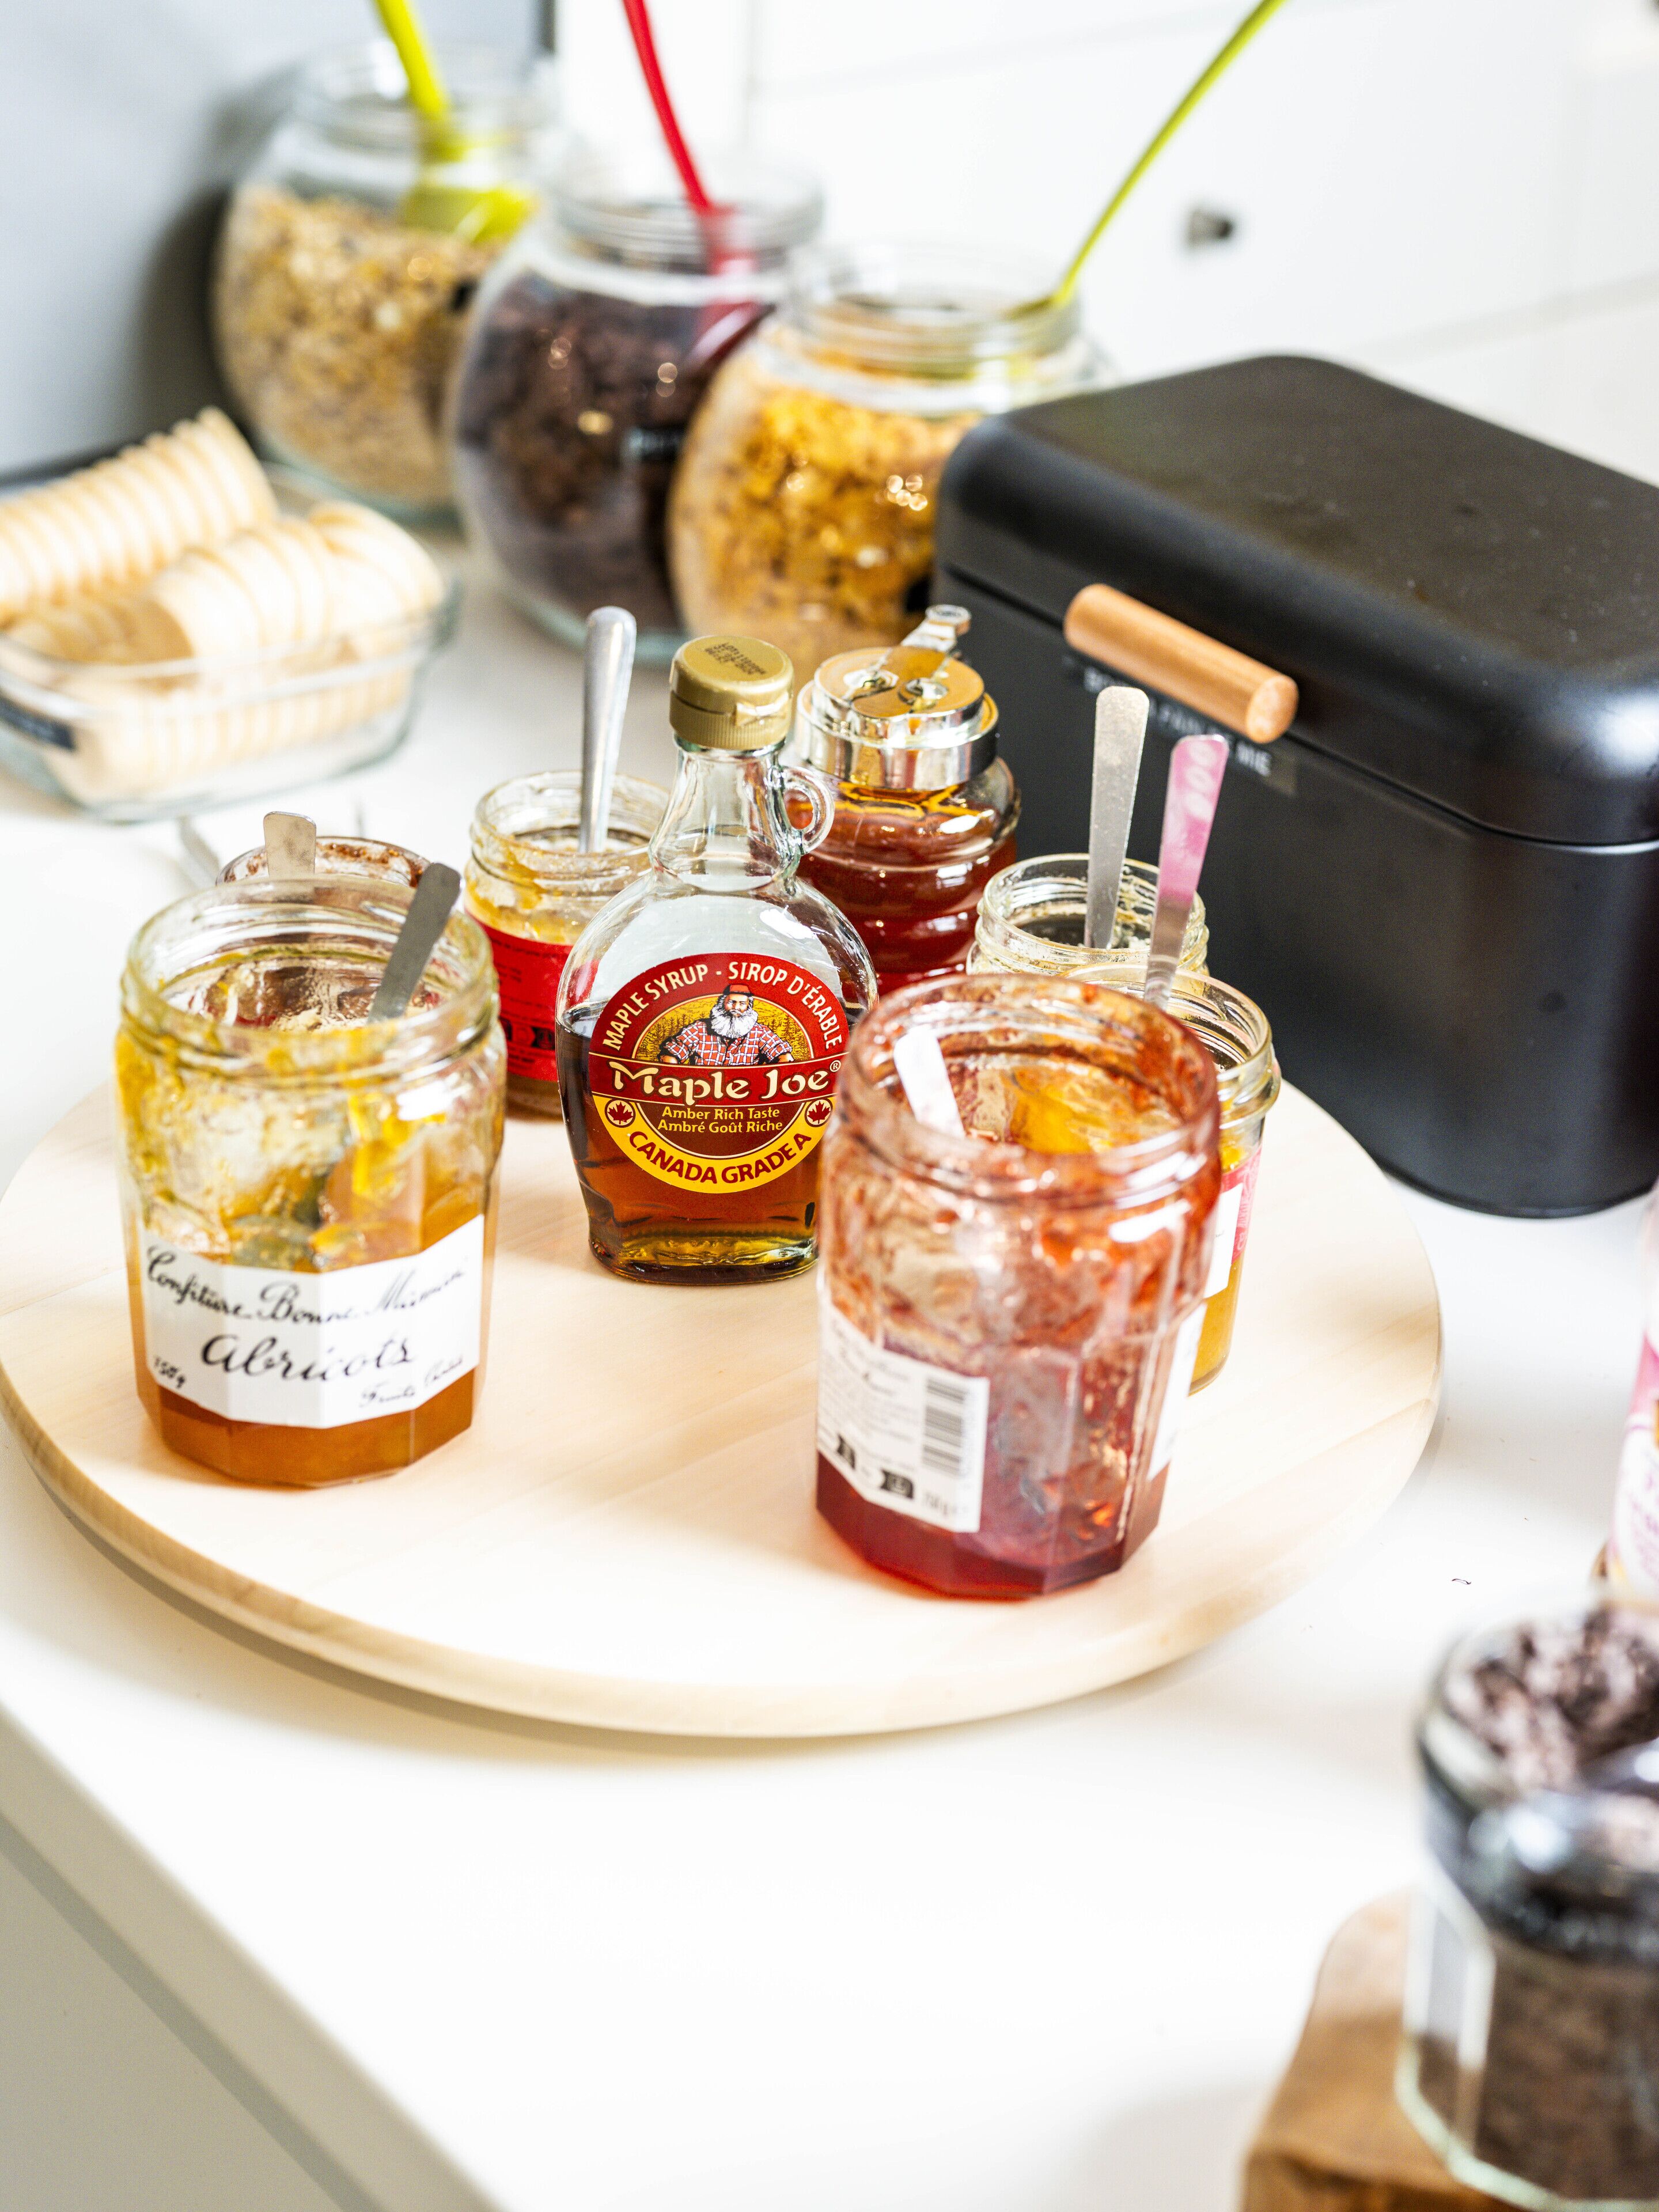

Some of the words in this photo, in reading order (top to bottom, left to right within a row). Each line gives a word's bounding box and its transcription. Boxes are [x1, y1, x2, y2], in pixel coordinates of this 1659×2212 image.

[603, 992, 649, 1051] MAPLE
[645, 964, 708, 1000] SYRUP
[729, 961, 787, 986] SIROP
[787, 975, 843, 1050] D'ÉRABLE
[608, 1060, 749, 1106] Maple
[657, 1122, 706, 1134] Ambré
[708, 1121, 742, 1134] Goût
[745, 1121, 783, 1132] Riche
[661, 1106, 710, 1120] Amber
[714, 1108, 743, 1120] Rich
[747, 1107, 780, 1118] Taste
[629, 1131, 718, 1184] CANADA
[721, 1142, 797, 1184] GRADE
[147, 1245, 251, 1319] Confiture
